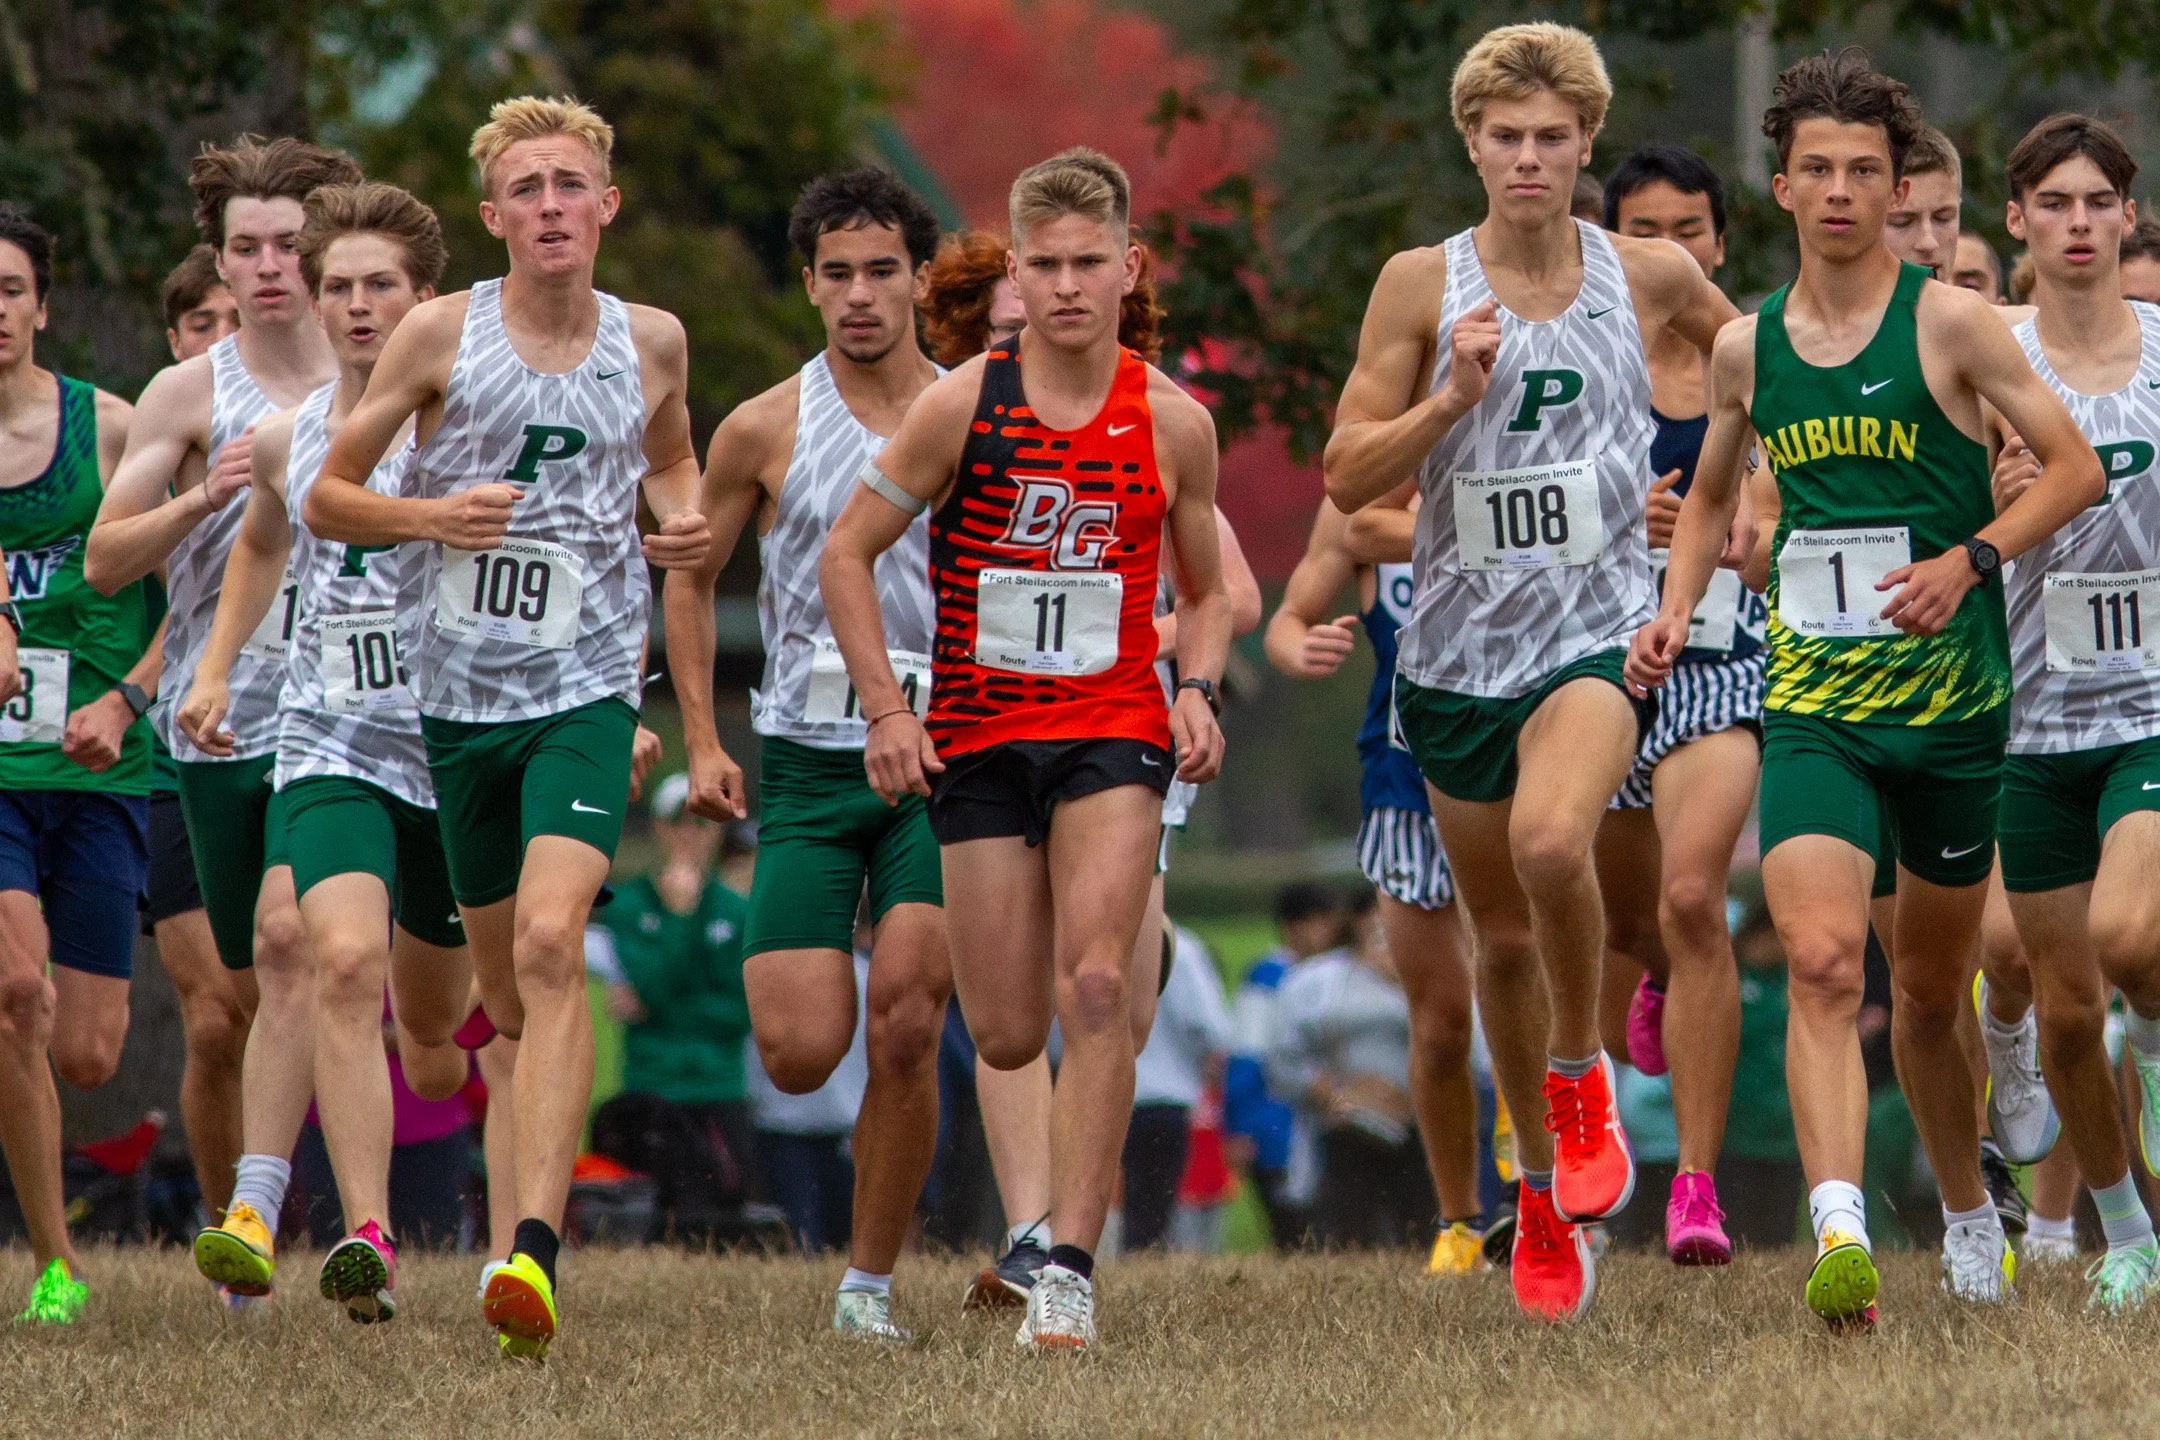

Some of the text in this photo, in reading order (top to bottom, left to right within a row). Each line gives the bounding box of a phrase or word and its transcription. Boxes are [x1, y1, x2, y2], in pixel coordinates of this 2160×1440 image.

[1506, 368, 1584, 432] P
[1764, 416, 1920, 475] AUBURN
[502, 424, 587, 483] P
[1461, 467, 1583, 487] Fort Steilacoom Invite
[992, 475, 1121, 571] BG
[1485, 484, 1569, 549] 108
[1787, 533, 1896, 546] ort Steilacoom Invite
[499, 543, 573, 560] lacoom Invite
[1484, 556, 1502, 564] Rou
[473, 553, 551, 622] 109
[989, 574, 1110, 588] Fort Steilacoom Invite
[1828, 551, 1847, 613] 1
[2052, 577, 2074, 588] Fort
[2077, 577, 2139, 588] Steilacoom
[325, 620, 344, 629] Fort
[457, 616, 478, 627] Rout
[1033, 592, 1066, 652] 11
[1801, 620, 1825, 630] Route
[2087, 590, 2141, 651] 111
[264, 644, 286, 655] Rout
[912, 658, 930, 669] Invi
[1000, 655, 1026, 666] Route
[345, 698, 364, 706] Rout
